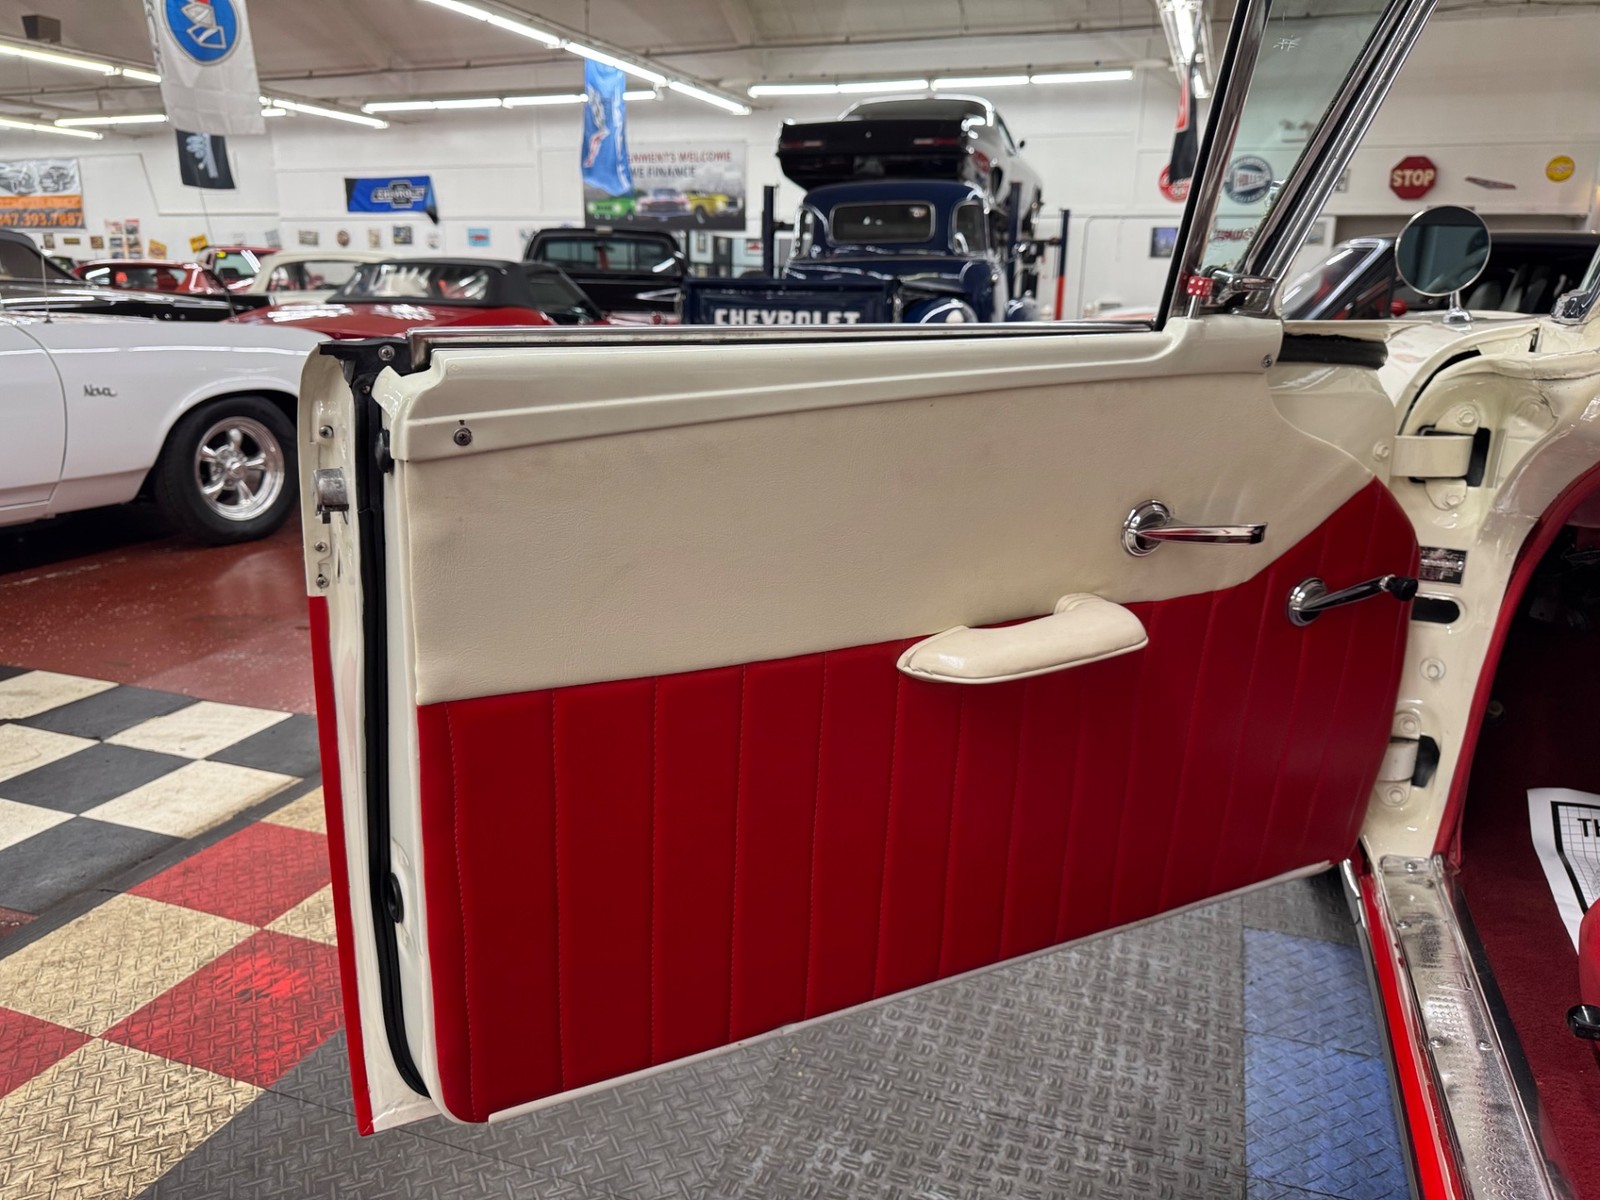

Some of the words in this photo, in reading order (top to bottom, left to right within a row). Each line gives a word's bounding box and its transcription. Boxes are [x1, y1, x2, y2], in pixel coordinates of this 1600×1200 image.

[679, 151, 732, 162] WELCOME
[646, 166, 697, 178] FINANCE
[1392, 168, 1435, 187] STOP
[714, 308, 861, 326] CHEVROLET
[83, 383, 118, 398] Nova
